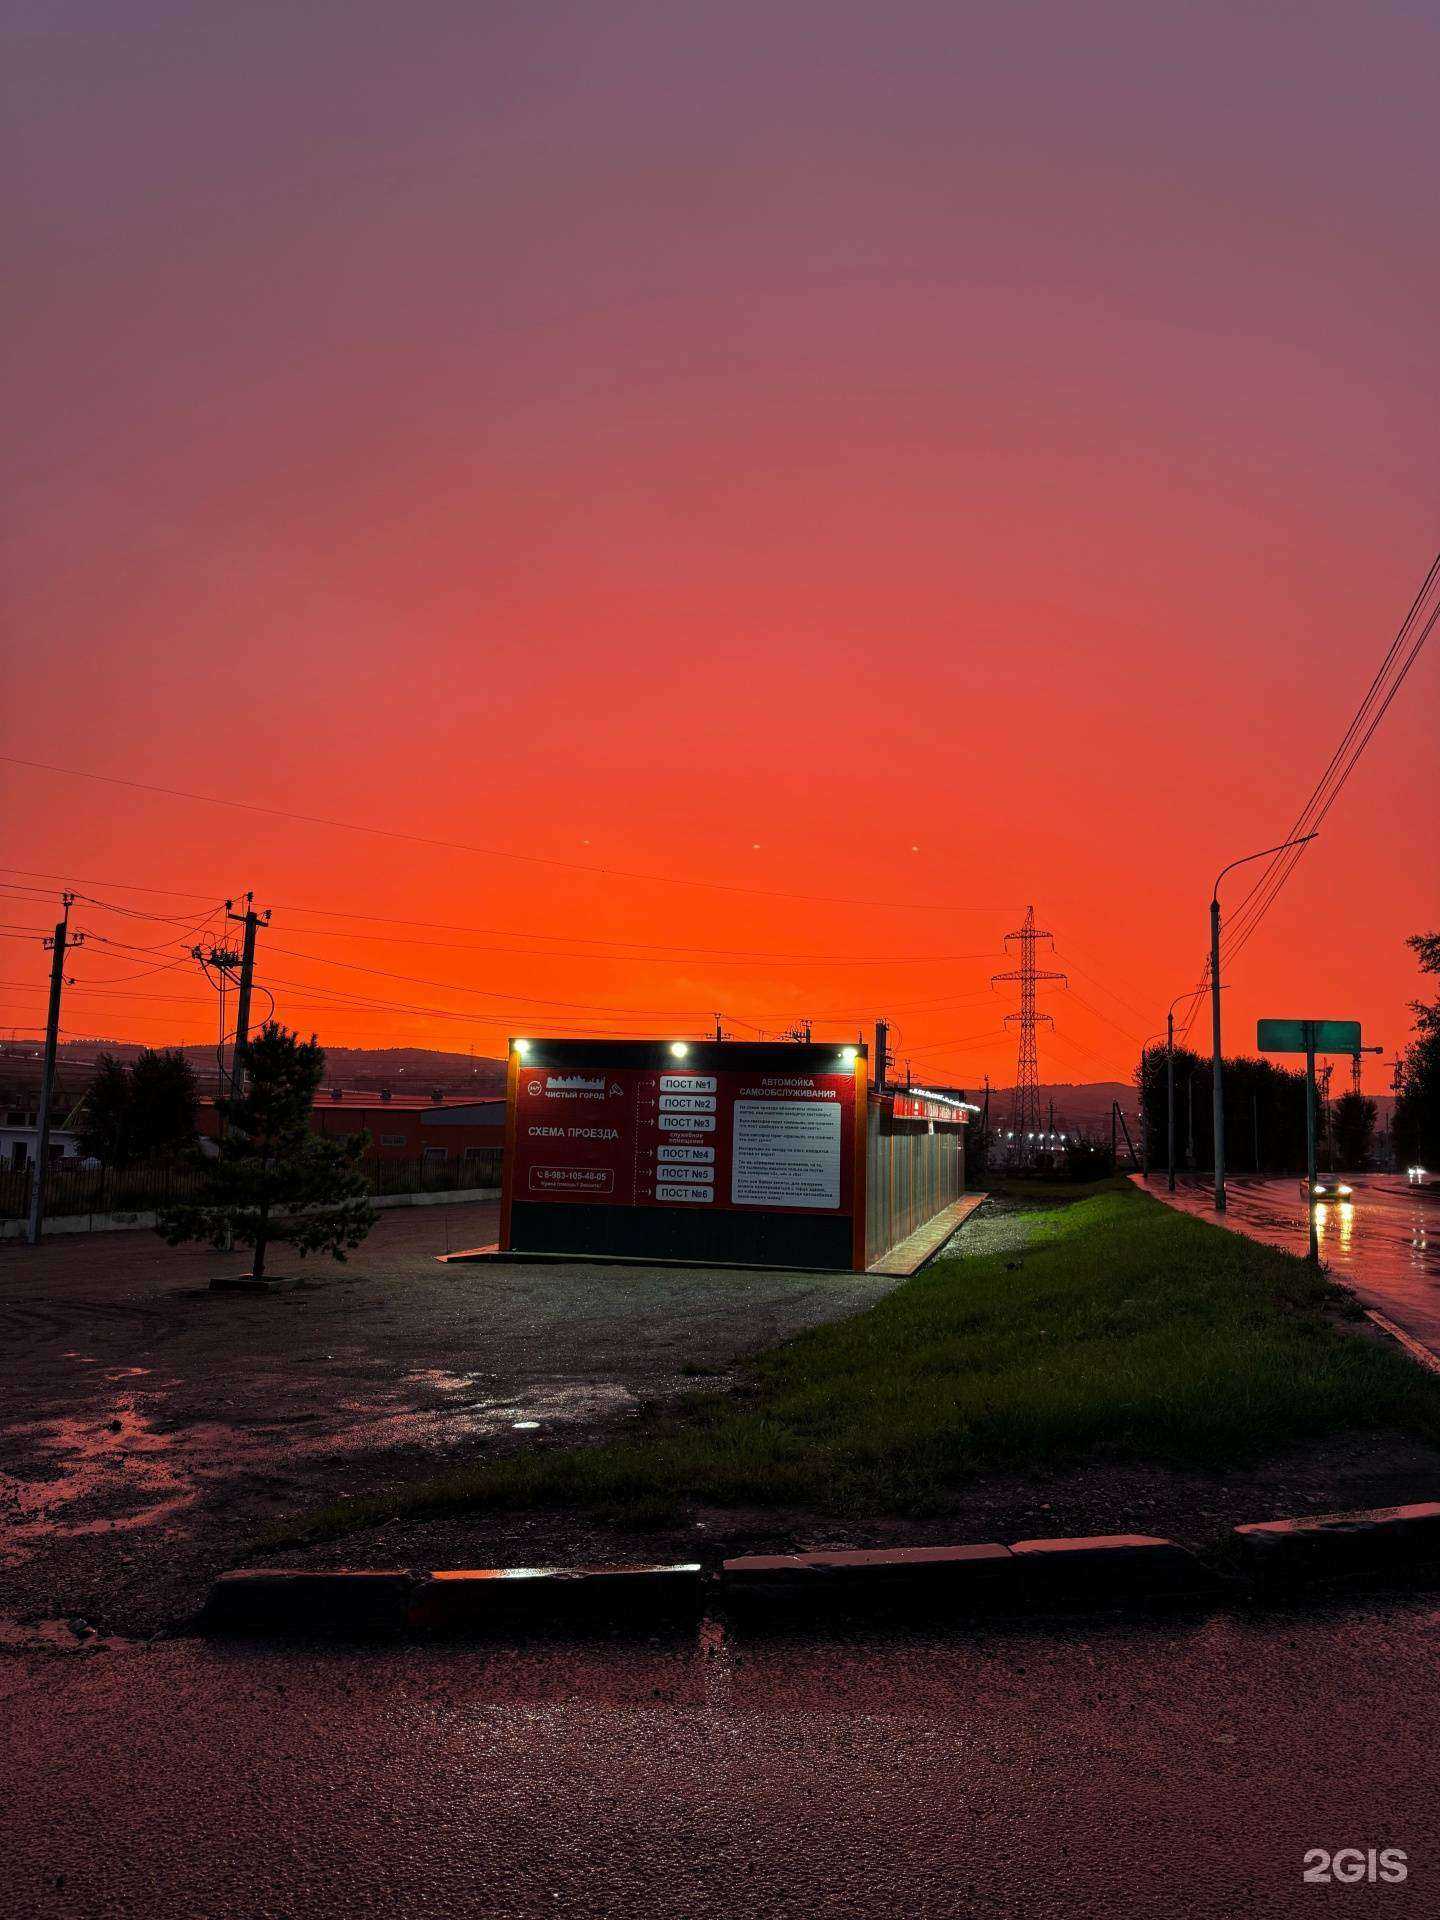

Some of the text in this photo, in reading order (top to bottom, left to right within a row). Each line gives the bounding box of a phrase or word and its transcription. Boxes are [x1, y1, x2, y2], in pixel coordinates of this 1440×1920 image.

[665, 1079, 711, 1089] ПОСТ №1
[761, 1077, 815, 1087] АВТОМОЙКА
[545, 1091, 605, 1100] ЧИСТЫЙ ГОРОД
[739, 1088, 836, 1098] САМООБСЛУЖИВАНИЯ
[664, 1098, 711, 1109] ПОСТ №2
[664, 1118, 710, 1128] ПОСТ №3
[528, 1126, 619, 1140] СХЕМА ПРОЕЗДА
[662, 1149, 709, 1159] ПОСТ №4
[662, 1168, 708, 1179] ПОСТ №5
[661, 1188, 708, 1199] ПОСТ №6
